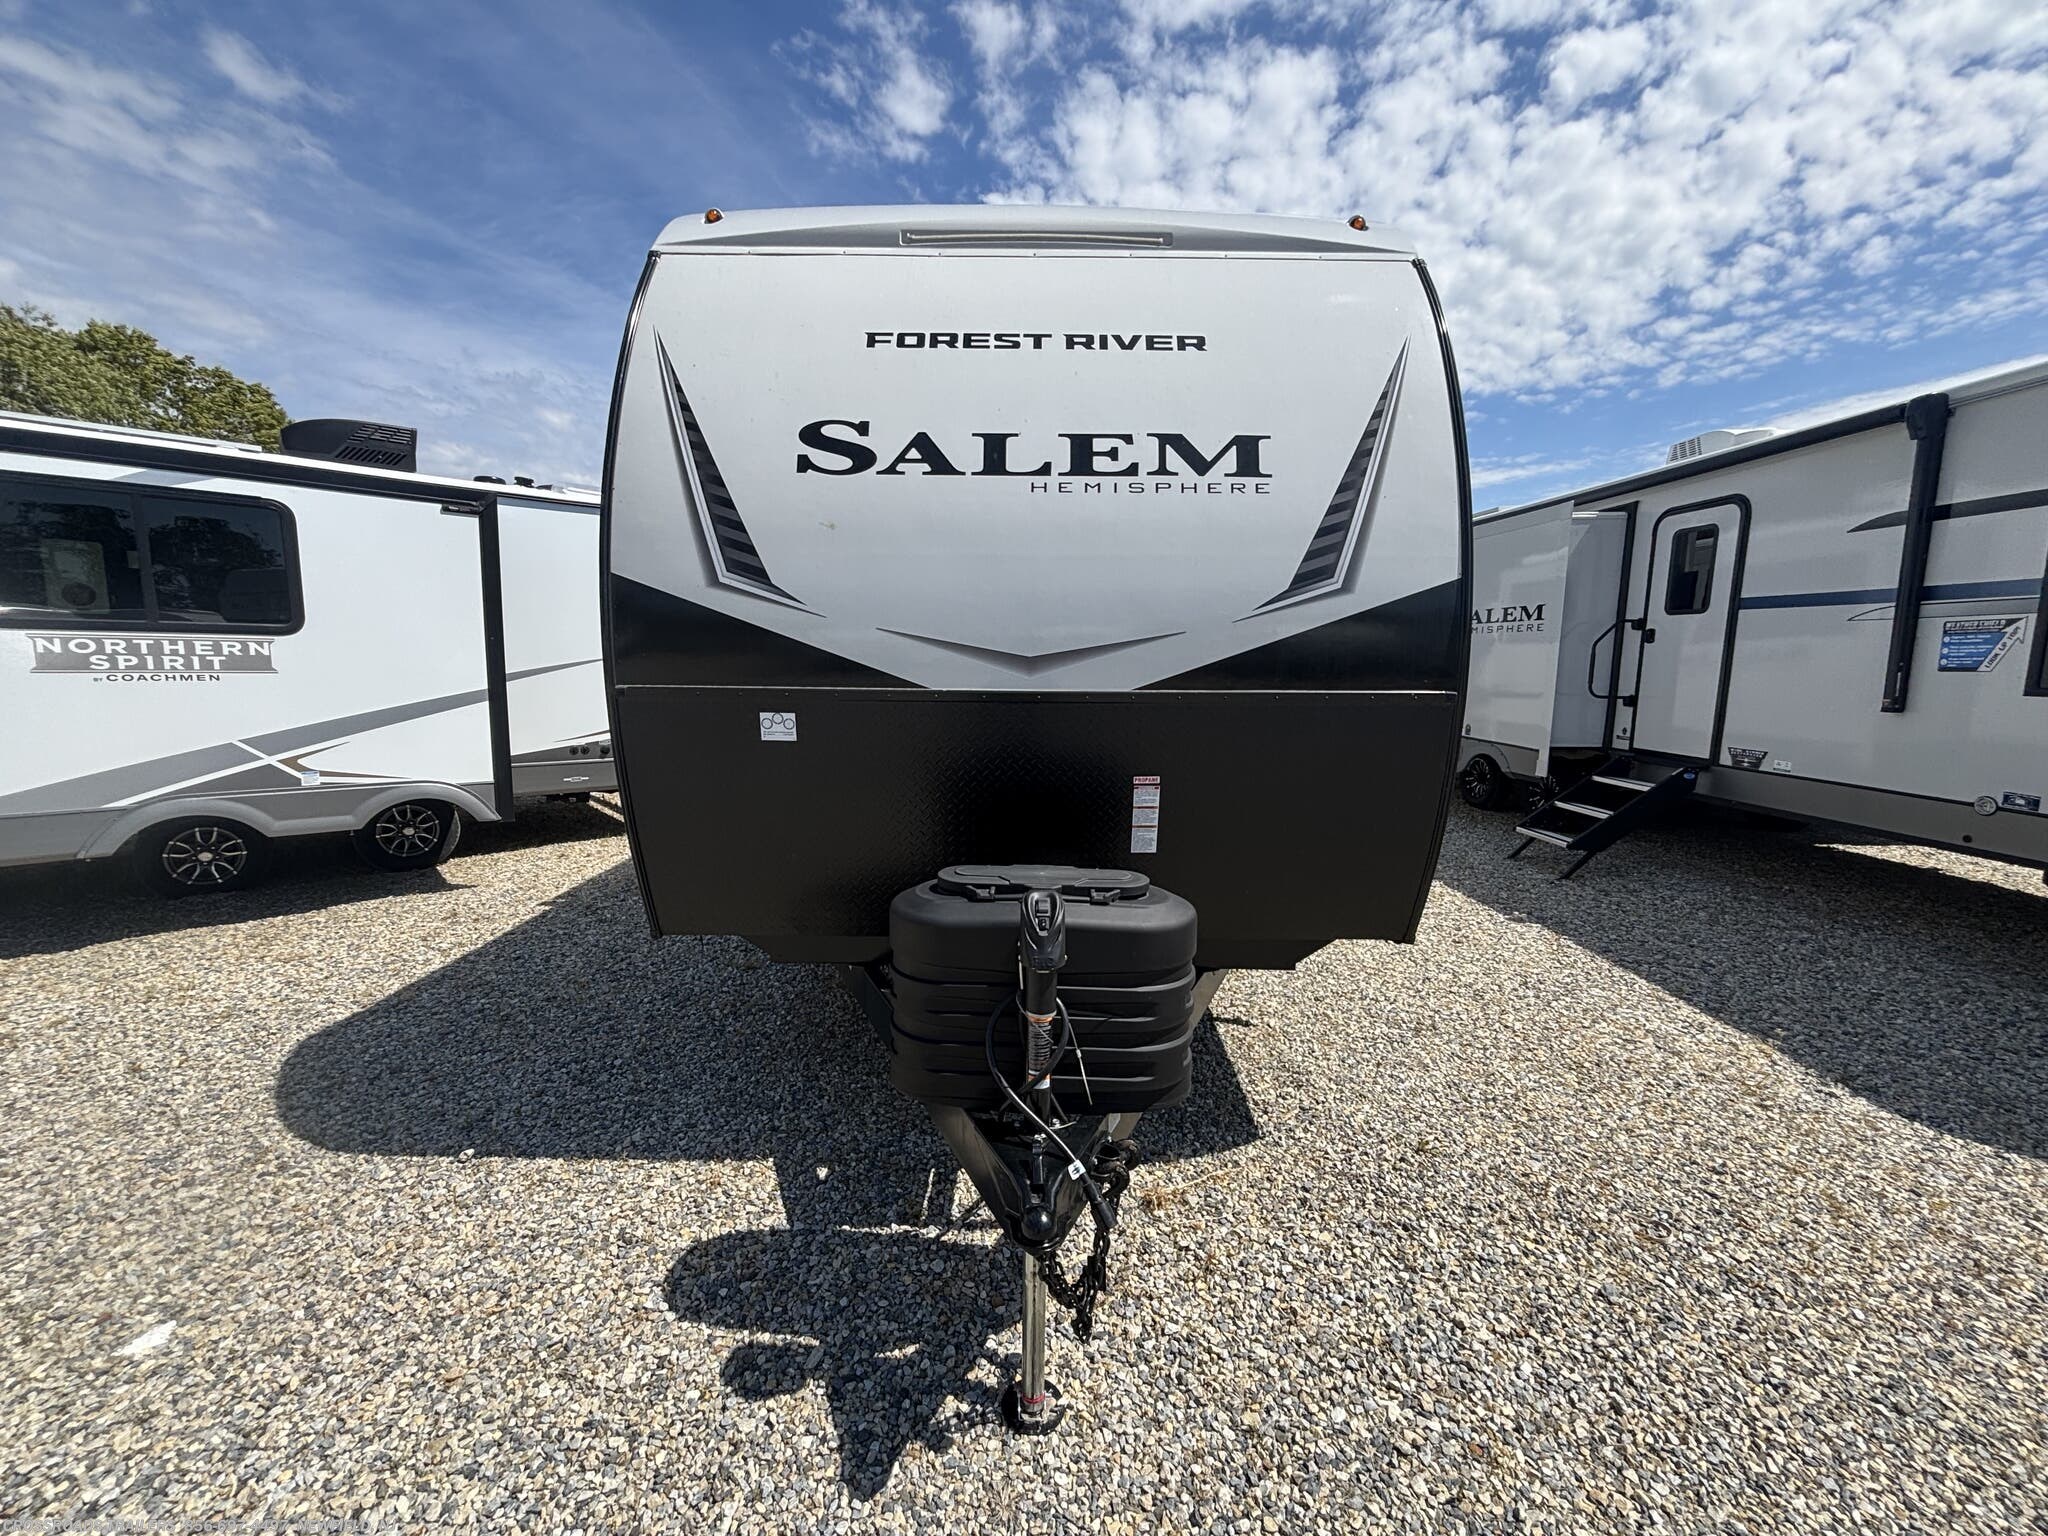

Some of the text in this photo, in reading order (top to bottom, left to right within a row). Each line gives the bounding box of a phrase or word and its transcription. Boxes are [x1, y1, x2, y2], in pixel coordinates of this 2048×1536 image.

[865, 331, 1208, 352] FOREST RIVER
[796, 419, 1273, 478] SALEM
[1030, 482, 1271, 495] HEMISPHERE
[1472, 604, 1546, 624] ALEM
[1472, 623, 1544, 634] MISPHERE
[33, 637, 271, 656] NORTHERN
[89, 655, 226, 670] SPIRIT
[106, 674, 221, 682] COACHMEN
